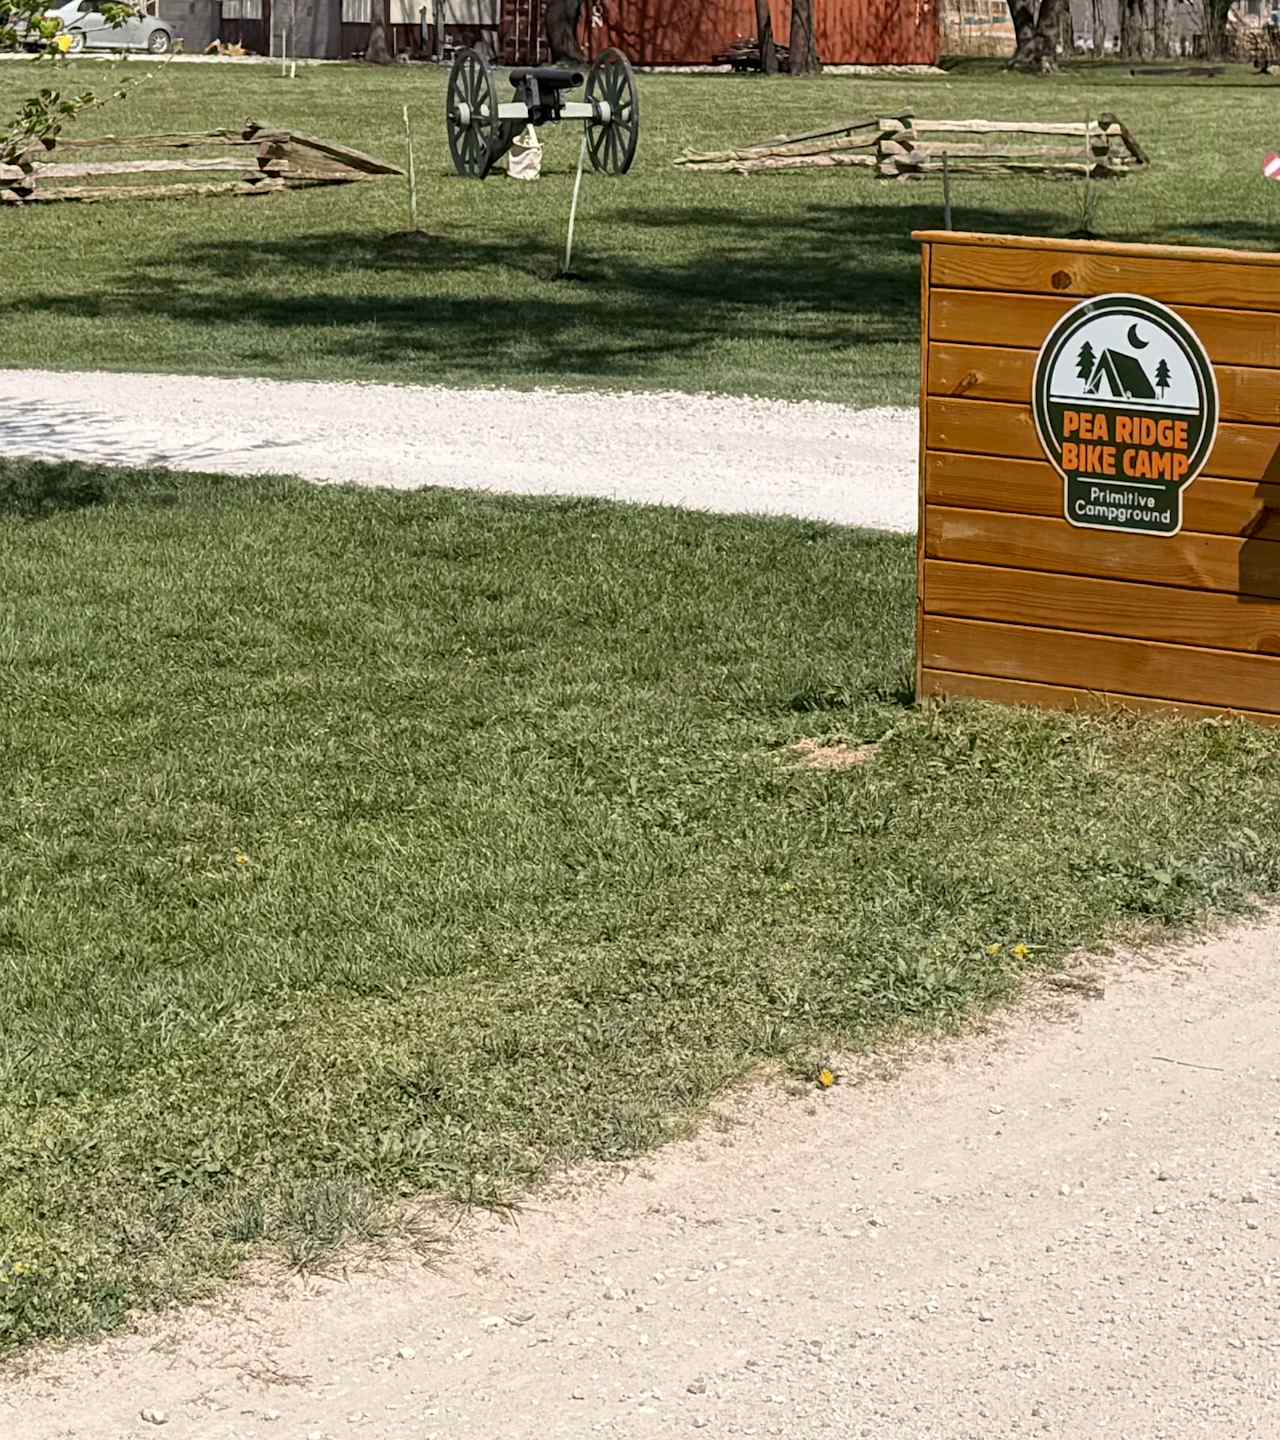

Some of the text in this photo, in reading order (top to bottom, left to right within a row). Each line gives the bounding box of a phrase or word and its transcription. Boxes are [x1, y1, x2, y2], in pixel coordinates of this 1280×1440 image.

[1063, 410, 1188, 449] PEA RIDGE
[1062, 442, 1189, 481] BIKE CAMP
[1075, 500, 1171, 523] Campground
[1090, 487, 1155, 508] Primitive
